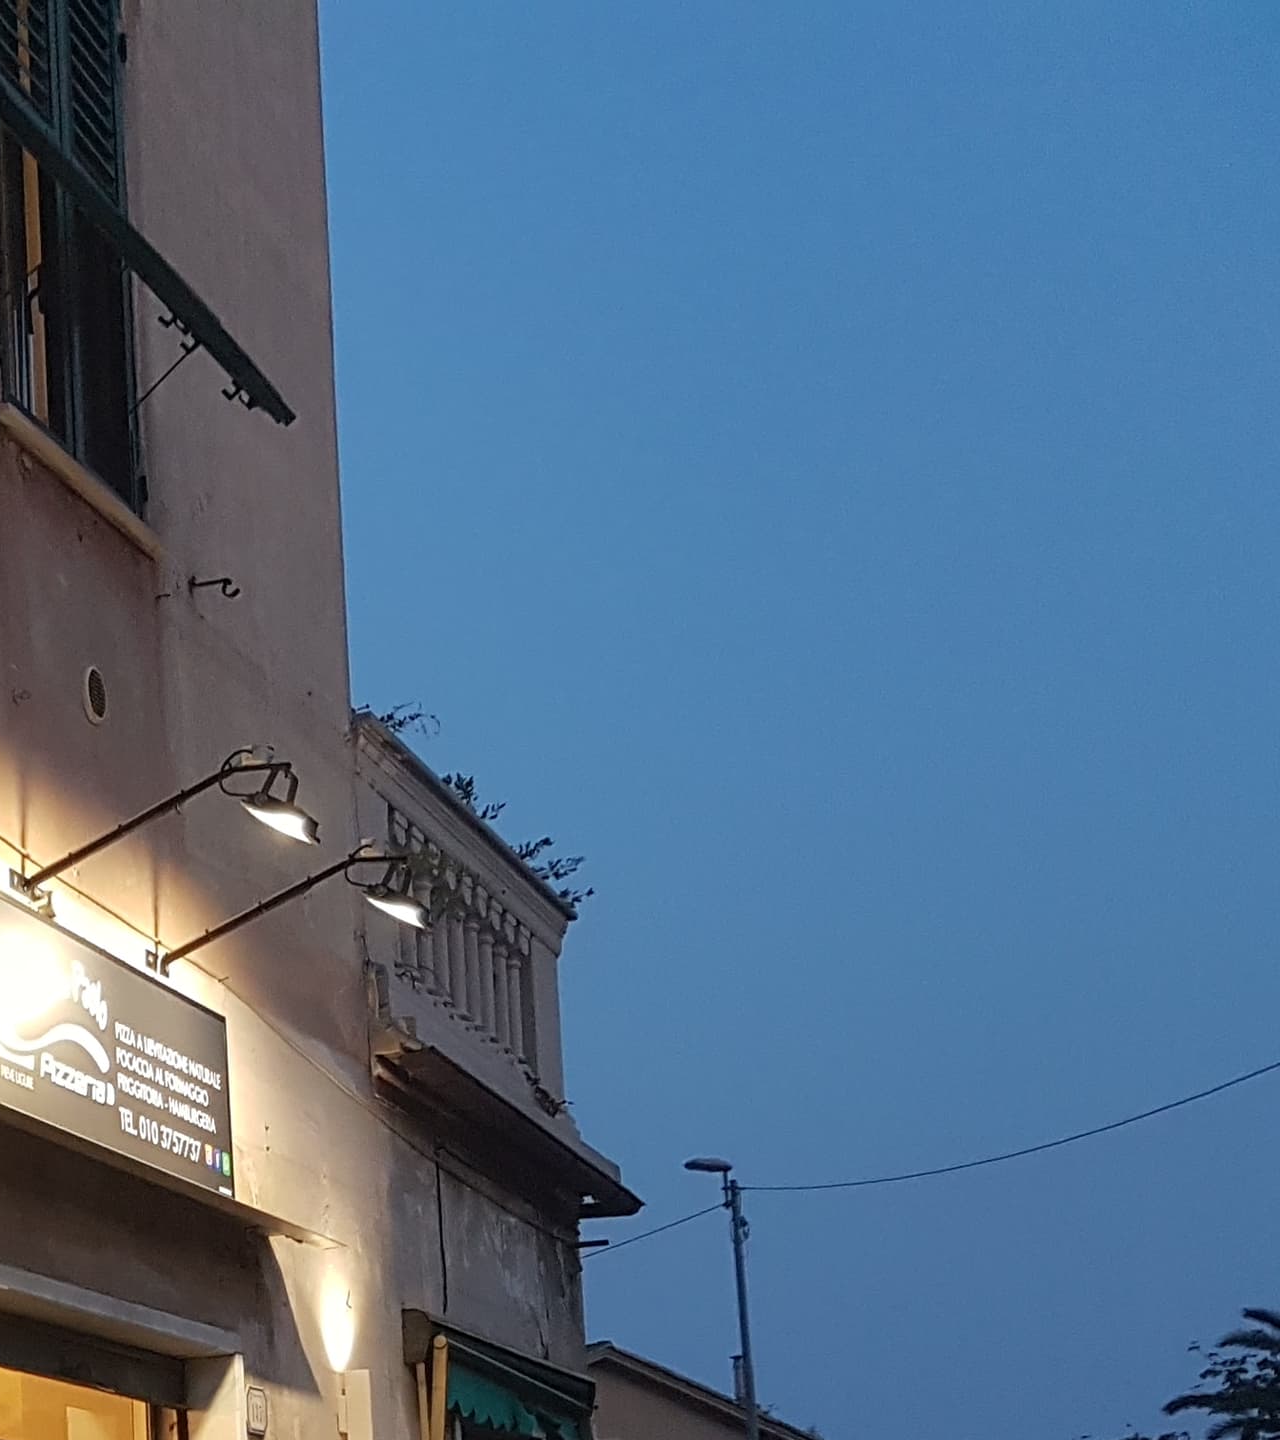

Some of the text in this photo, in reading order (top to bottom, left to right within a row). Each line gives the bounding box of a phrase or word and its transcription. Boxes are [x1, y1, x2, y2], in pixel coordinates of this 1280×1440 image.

[115, 1021, 136, 1048] PIZZA
[136, 1033, 144, 1051] A
[116, 1046, 209, 1108] FOCACCIA AL FORMAGGIO
[139, 1115, 159, 1145] 010
